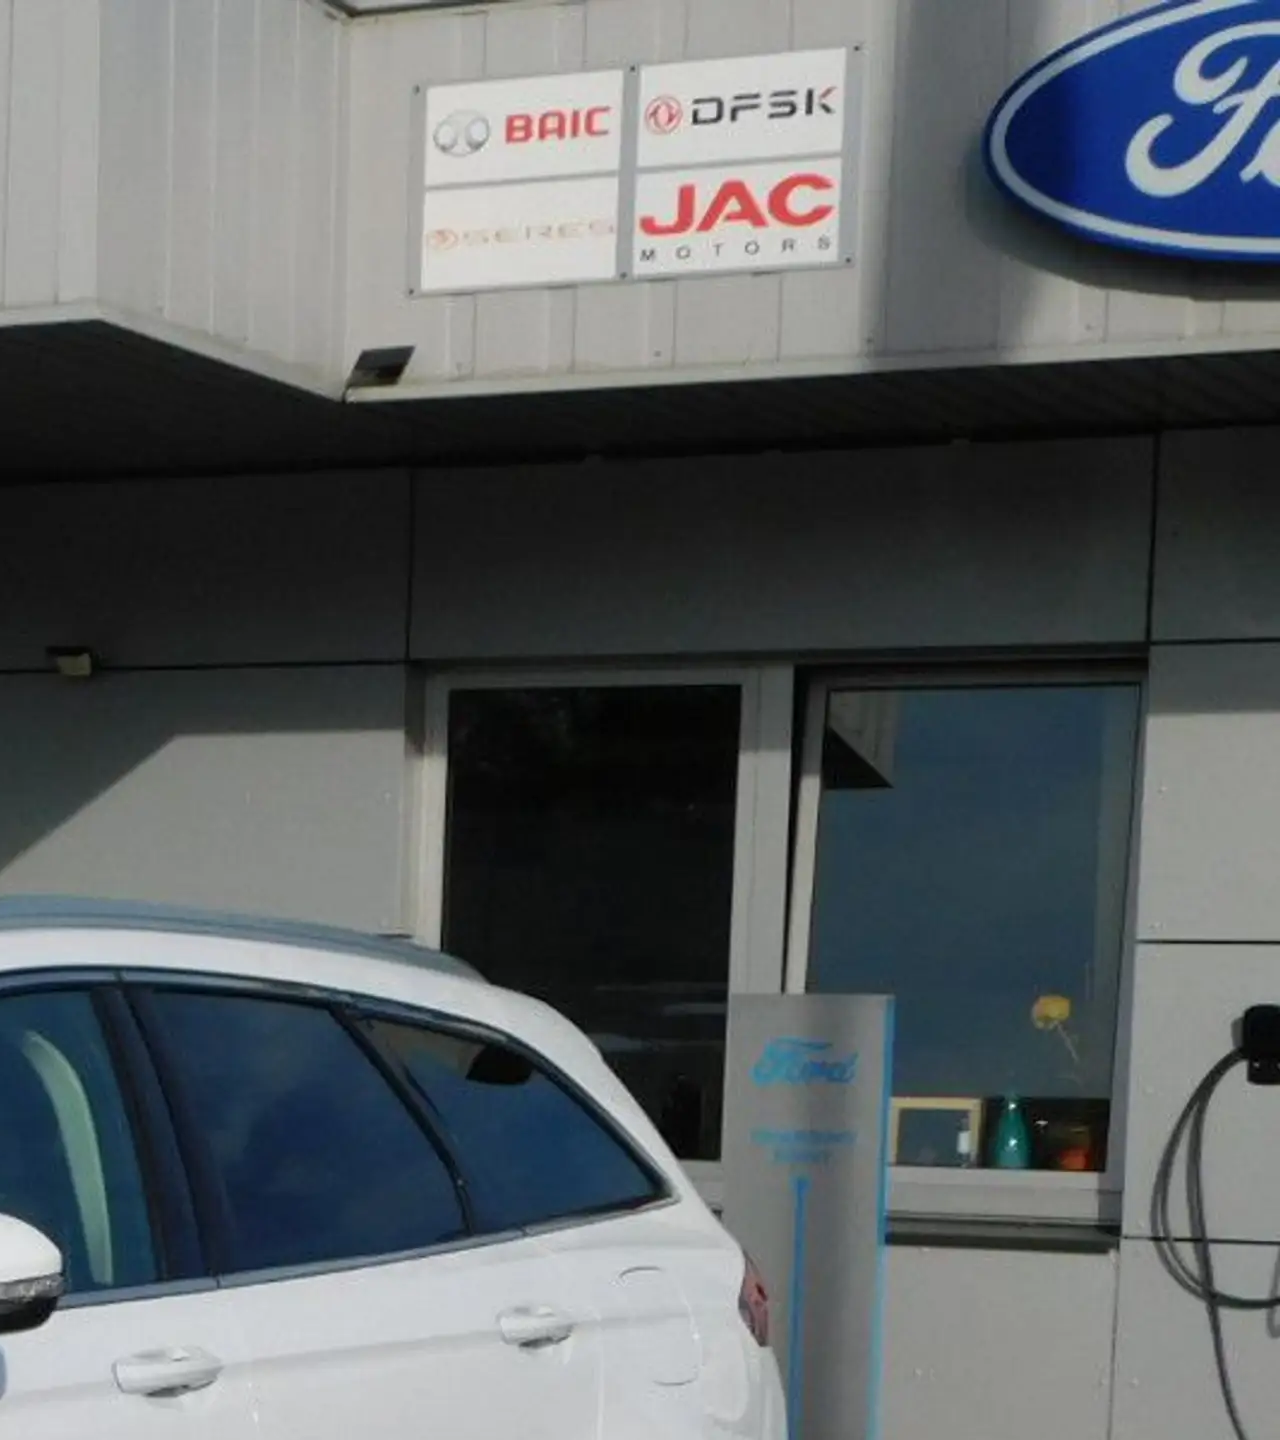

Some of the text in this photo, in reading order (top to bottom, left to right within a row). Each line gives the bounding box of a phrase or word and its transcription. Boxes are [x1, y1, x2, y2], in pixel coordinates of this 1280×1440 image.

[505, 105, 612, 144] BAIC
[691, 86, 838, 126] DFSK
[639, 173, 834, 237] JAC
[639, 236, 832, 263] MOTORS
